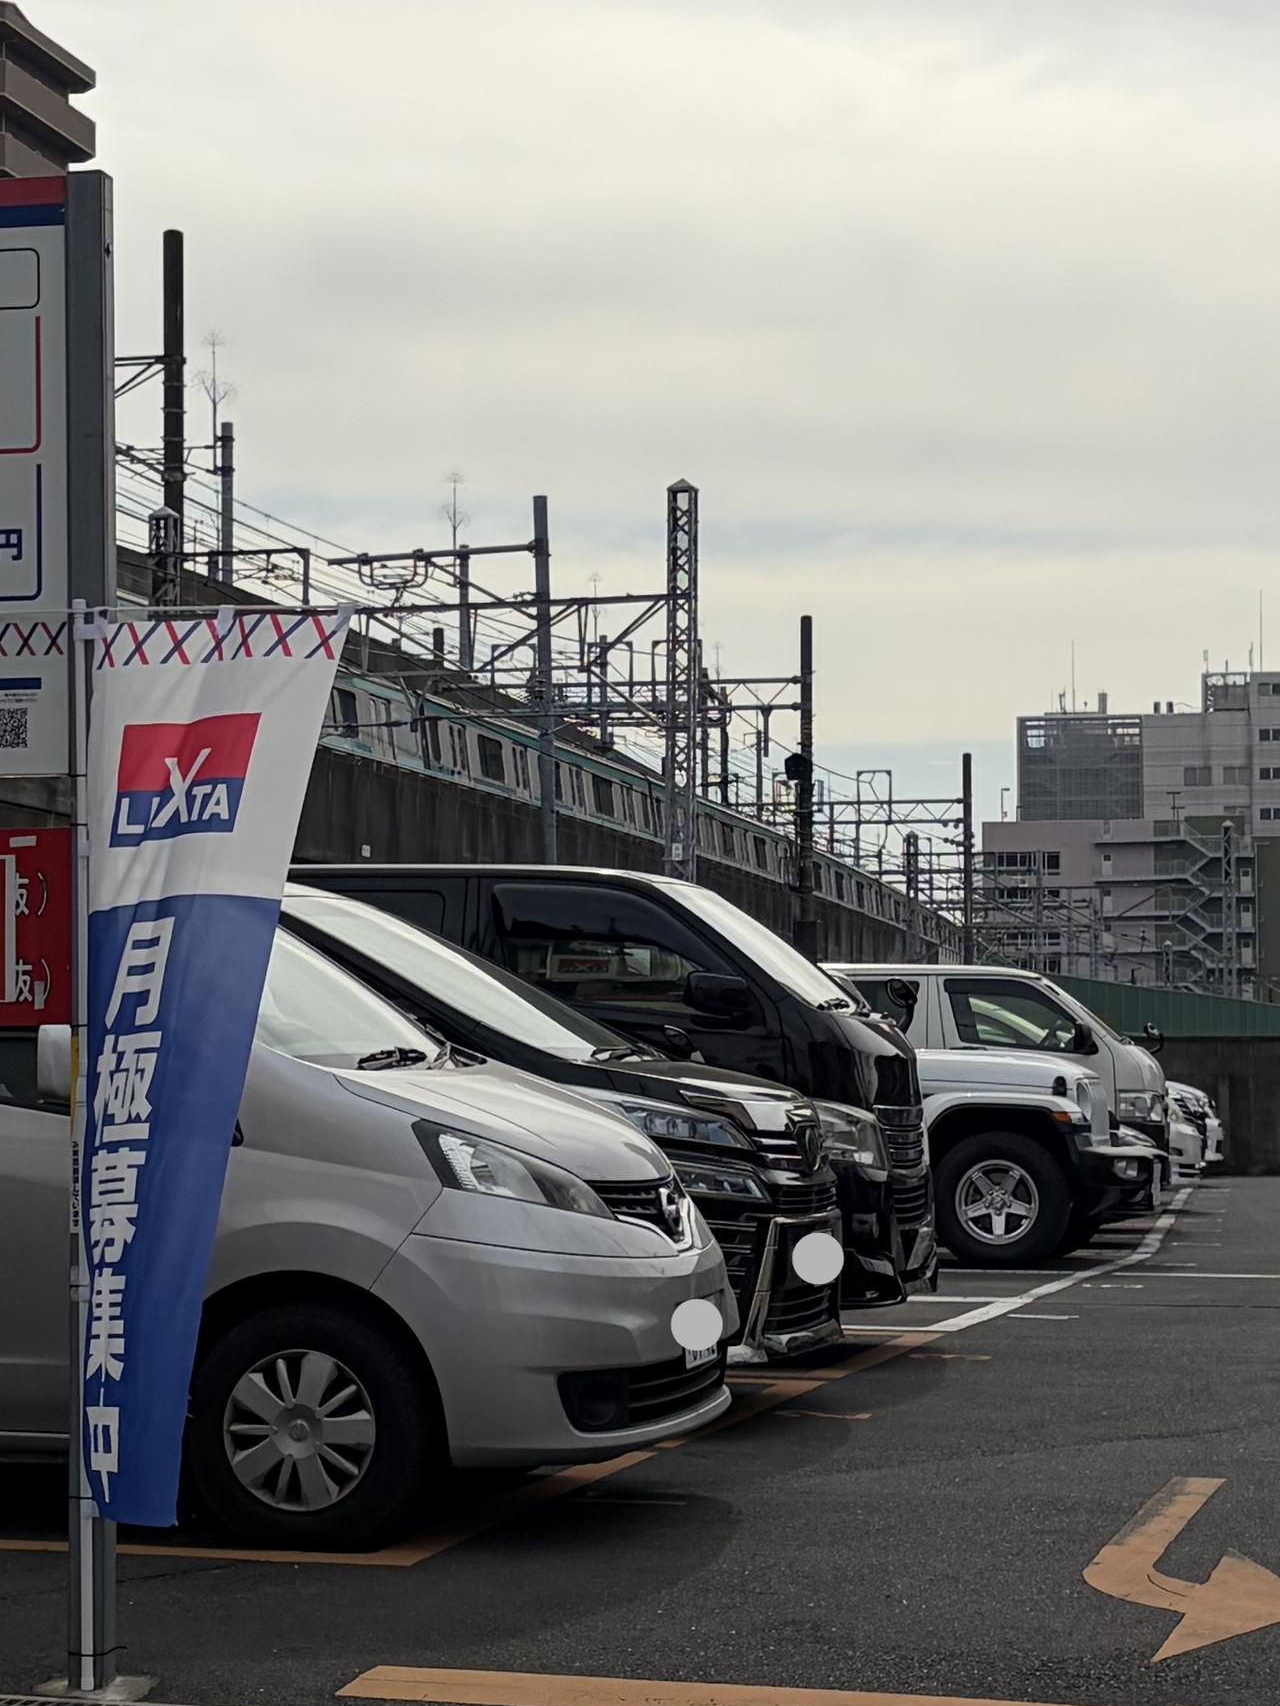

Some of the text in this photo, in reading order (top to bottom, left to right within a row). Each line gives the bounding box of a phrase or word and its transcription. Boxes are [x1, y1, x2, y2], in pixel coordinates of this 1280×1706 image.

[117, 748, 230, 835] LIXTA
[86, 916, 175, 1503] 月極募集中
